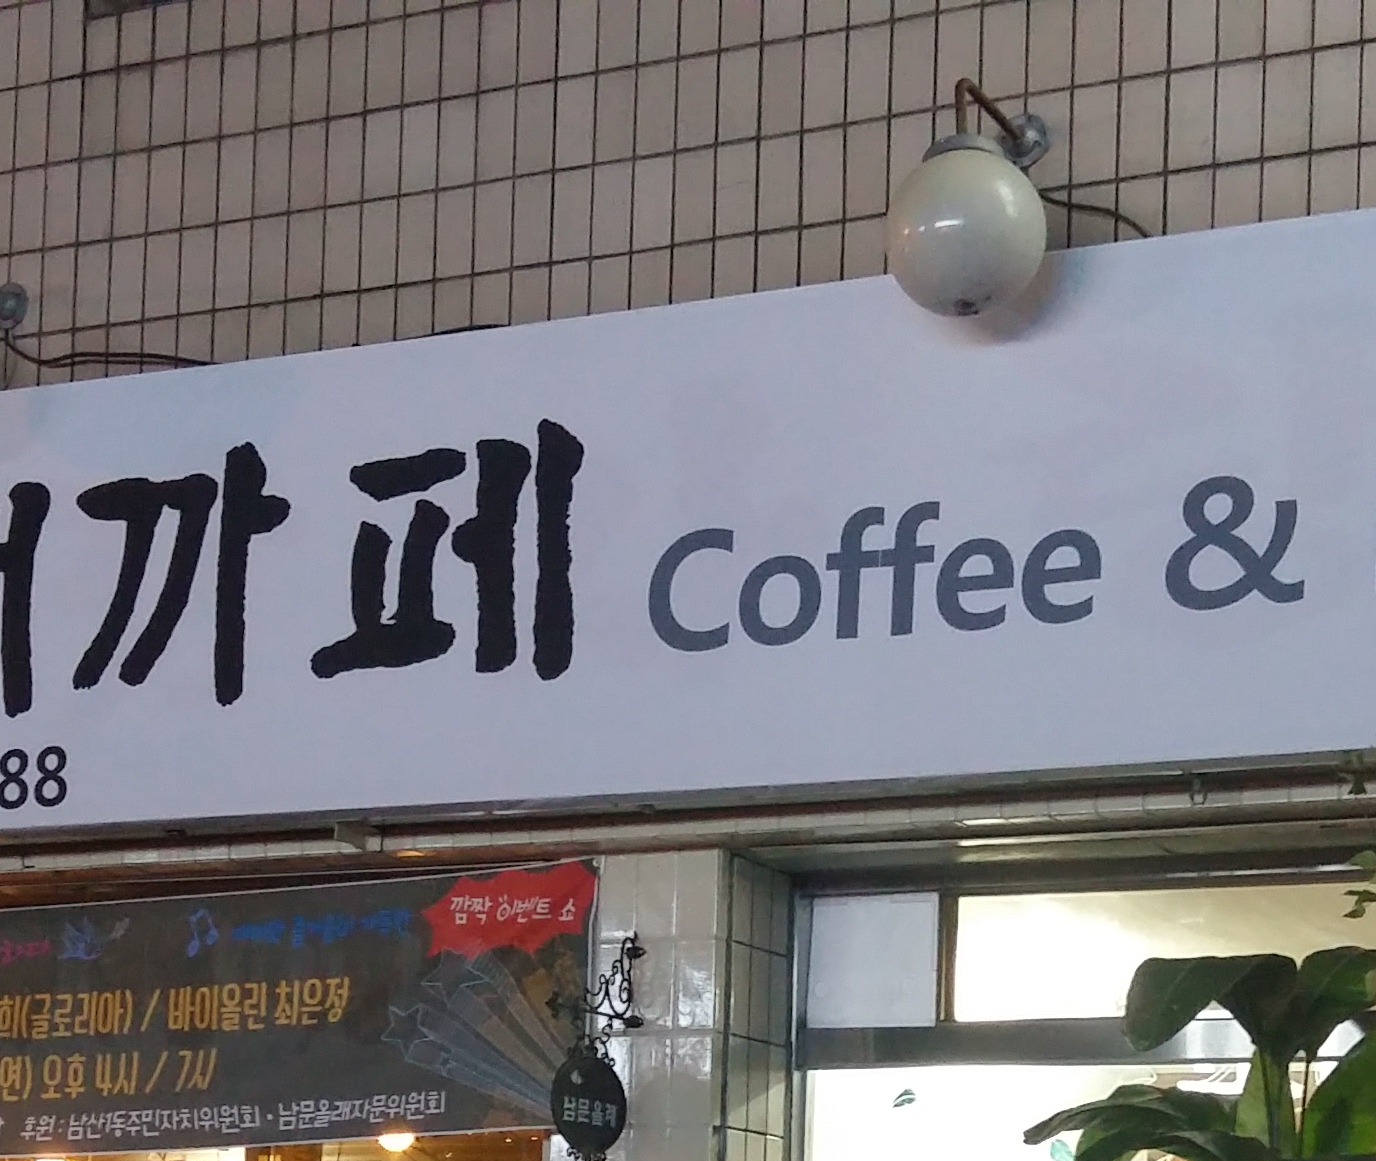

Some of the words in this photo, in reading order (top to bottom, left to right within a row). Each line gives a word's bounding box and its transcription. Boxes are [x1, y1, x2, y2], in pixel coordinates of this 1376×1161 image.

[647, 500, 1102, 653] Coffee
[1163, 474, 1306, 612] &
[449, 895, 492, 925] 깜짝
[496, 894, 552, 924] 이벤트
[558, 897, 576, 922] 쇼
[167, 982, 269, 1033] 바이올린
[274, 976, 351, 1026] 최은정
[39, 1052, 88, 1100] 오후
[94, 1050, 140, 1097] 4시
[174, 1047, 218, 1092] 7시
